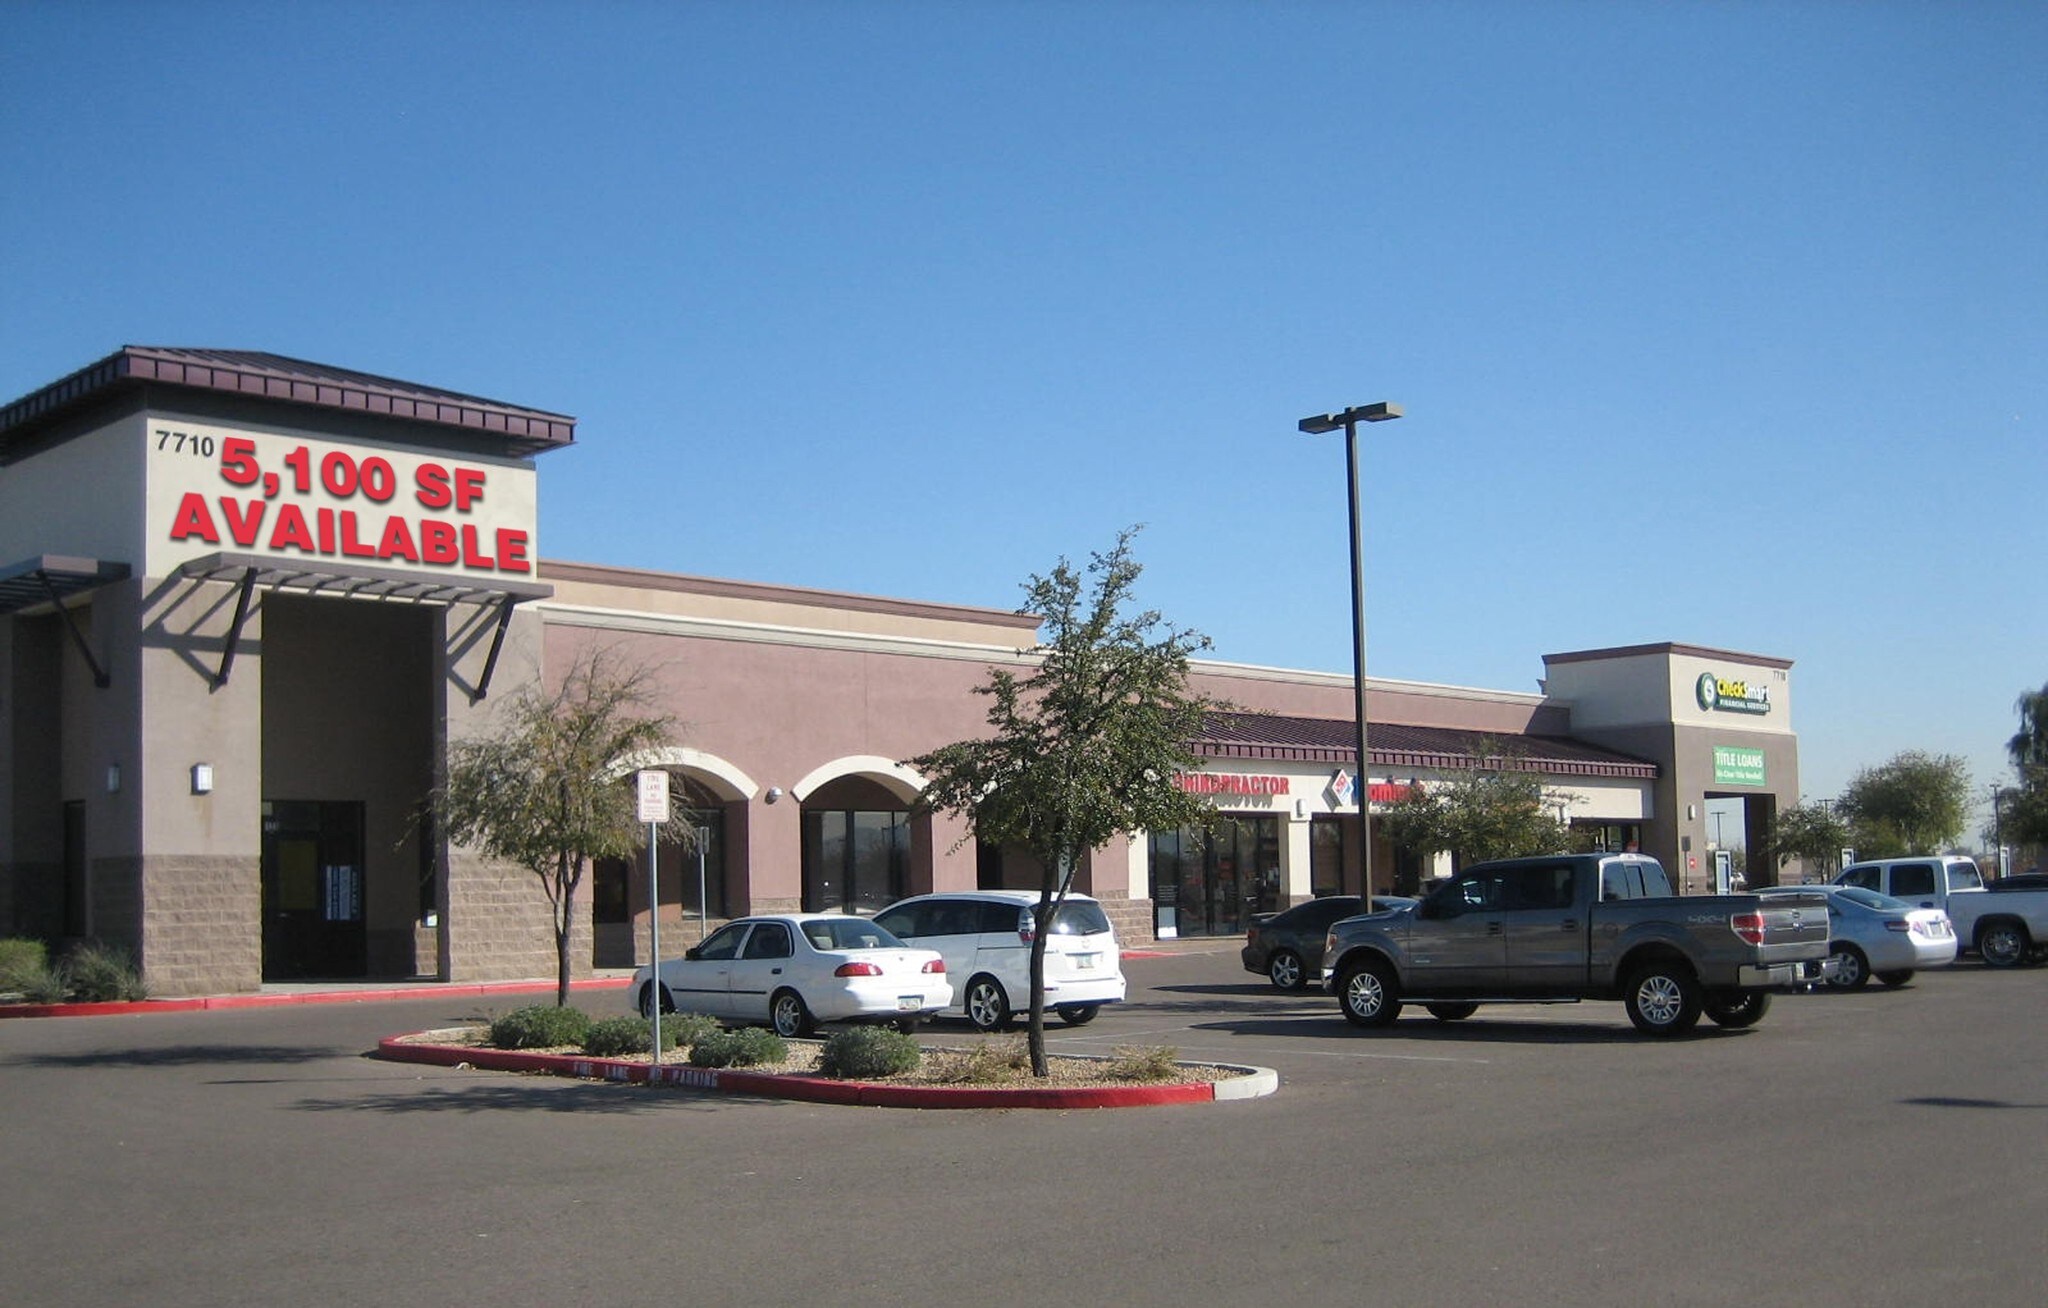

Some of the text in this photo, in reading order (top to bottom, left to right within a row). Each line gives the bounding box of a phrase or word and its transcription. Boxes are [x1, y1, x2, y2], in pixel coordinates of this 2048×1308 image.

[155, 430, 214, 457] 7710
[1715, 752, 1762, 768] TITLE LOANS
